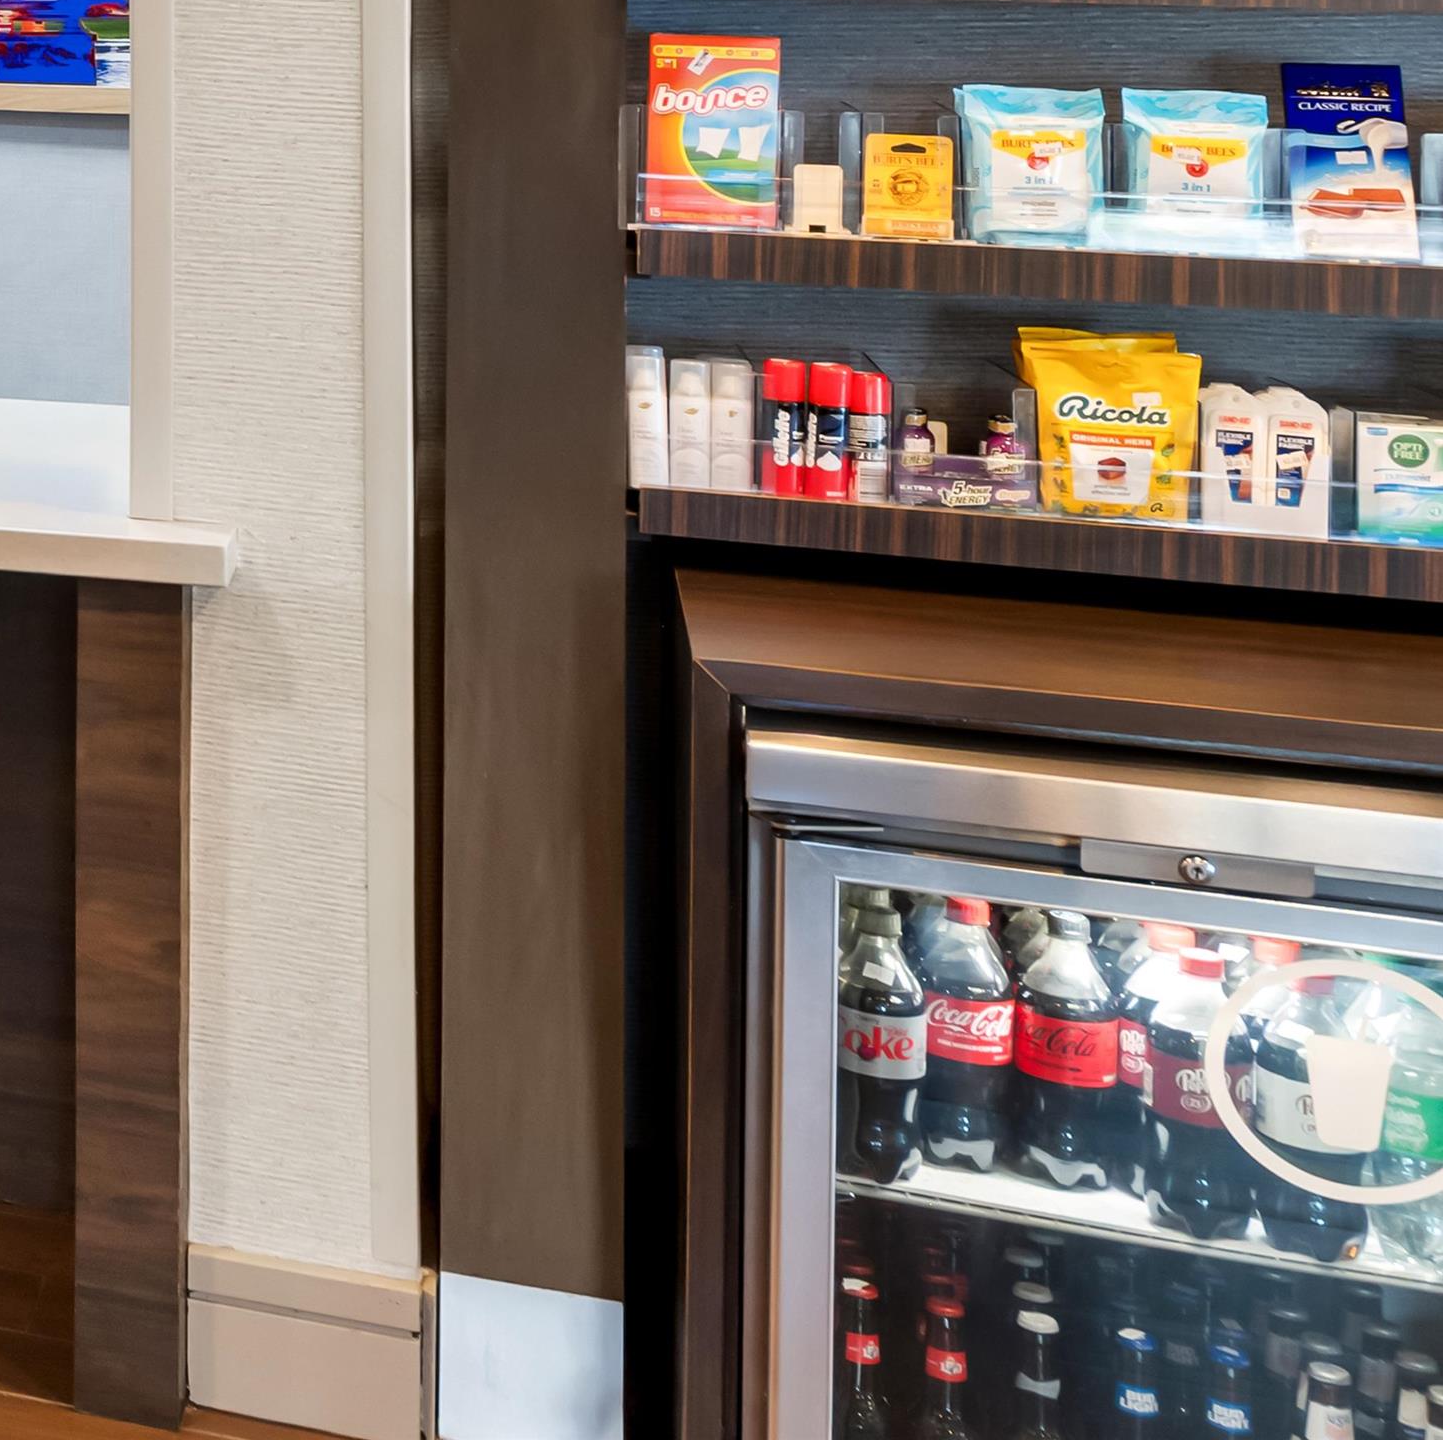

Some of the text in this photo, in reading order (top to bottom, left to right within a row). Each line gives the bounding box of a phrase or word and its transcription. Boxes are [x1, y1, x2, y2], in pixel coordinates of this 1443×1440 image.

[652, 84, 771, 115] bounce
[1298, 101, 1392, 113] CLASSIC RECIPE
[1206, 146, 1236, 156] BEES
[1024, 176, 1032, 185] 3
[1034, 176, 1047, 185] in
[1181, 182, 1190, 191] 3
[1191, 182, 1204, 192] in
[1058, 395, 1168, 425] Ricola
[773, 408, 791, 467] Gillette
[1072, 433, 1153, 447] ORIGINAL HERB
[899, 484, 934, 493] EXTRA
[953, 481, 991, 495] 5-hour
[949, 495, 990, 506] ENERGY
[841, 1025, 915, 1061] oke
